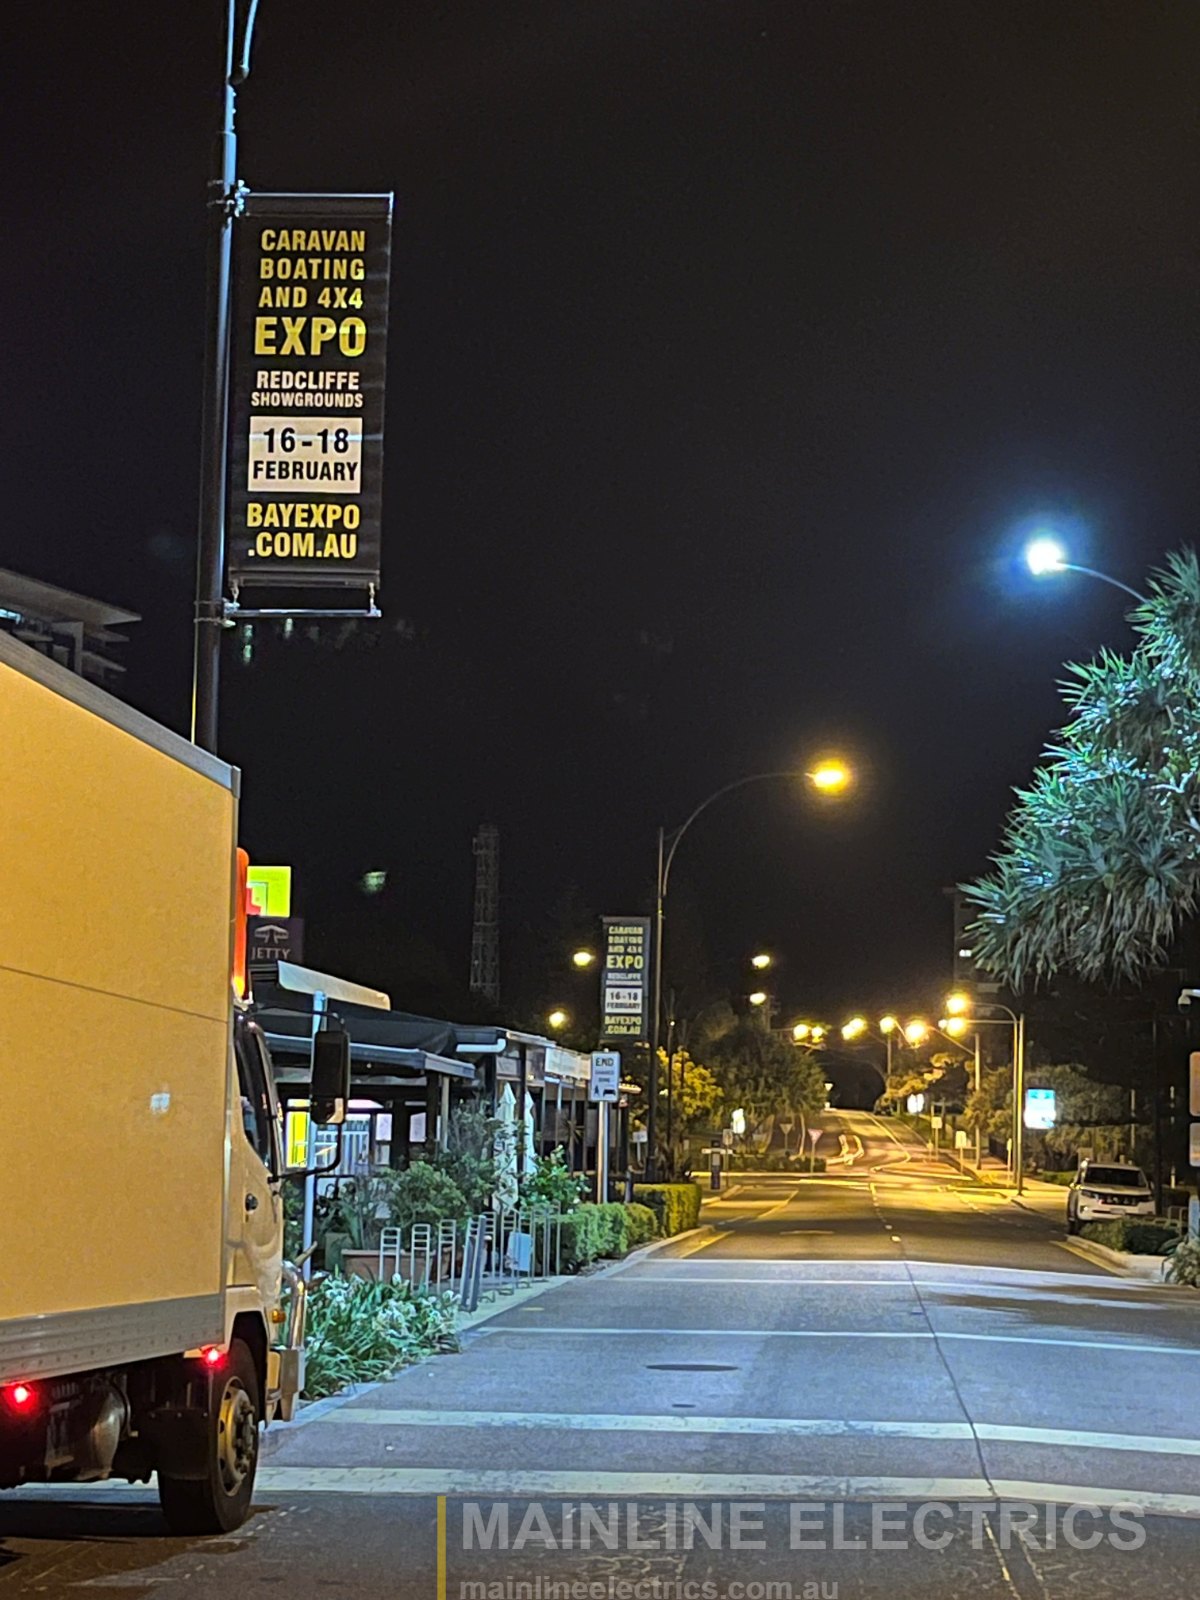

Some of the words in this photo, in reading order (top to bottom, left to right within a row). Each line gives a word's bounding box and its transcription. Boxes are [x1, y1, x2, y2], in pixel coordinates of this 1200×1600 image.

[261, 229, 366, 252] CARAVAN
[259, 257, 365, 281] BOATING
[258, 286, 308, 309] AND
[317, 287, 364, 310] 4X4
[254, 316, 367, 357] EXPO
[256, 370, 360, 391] REDCLIFFE
[251, 392, 363, 408] SHOWGROUNDS
[252, 460, 359, 482] FEBRUARY
[247, 502, 361, 530] BAYEXPO
[248, 532, 358, 559] .COM.AU
[251, 946, 291, 961] JETTY
[606, 954, 644, 970] EXPO
[595, 1057, 615, 1067] END
